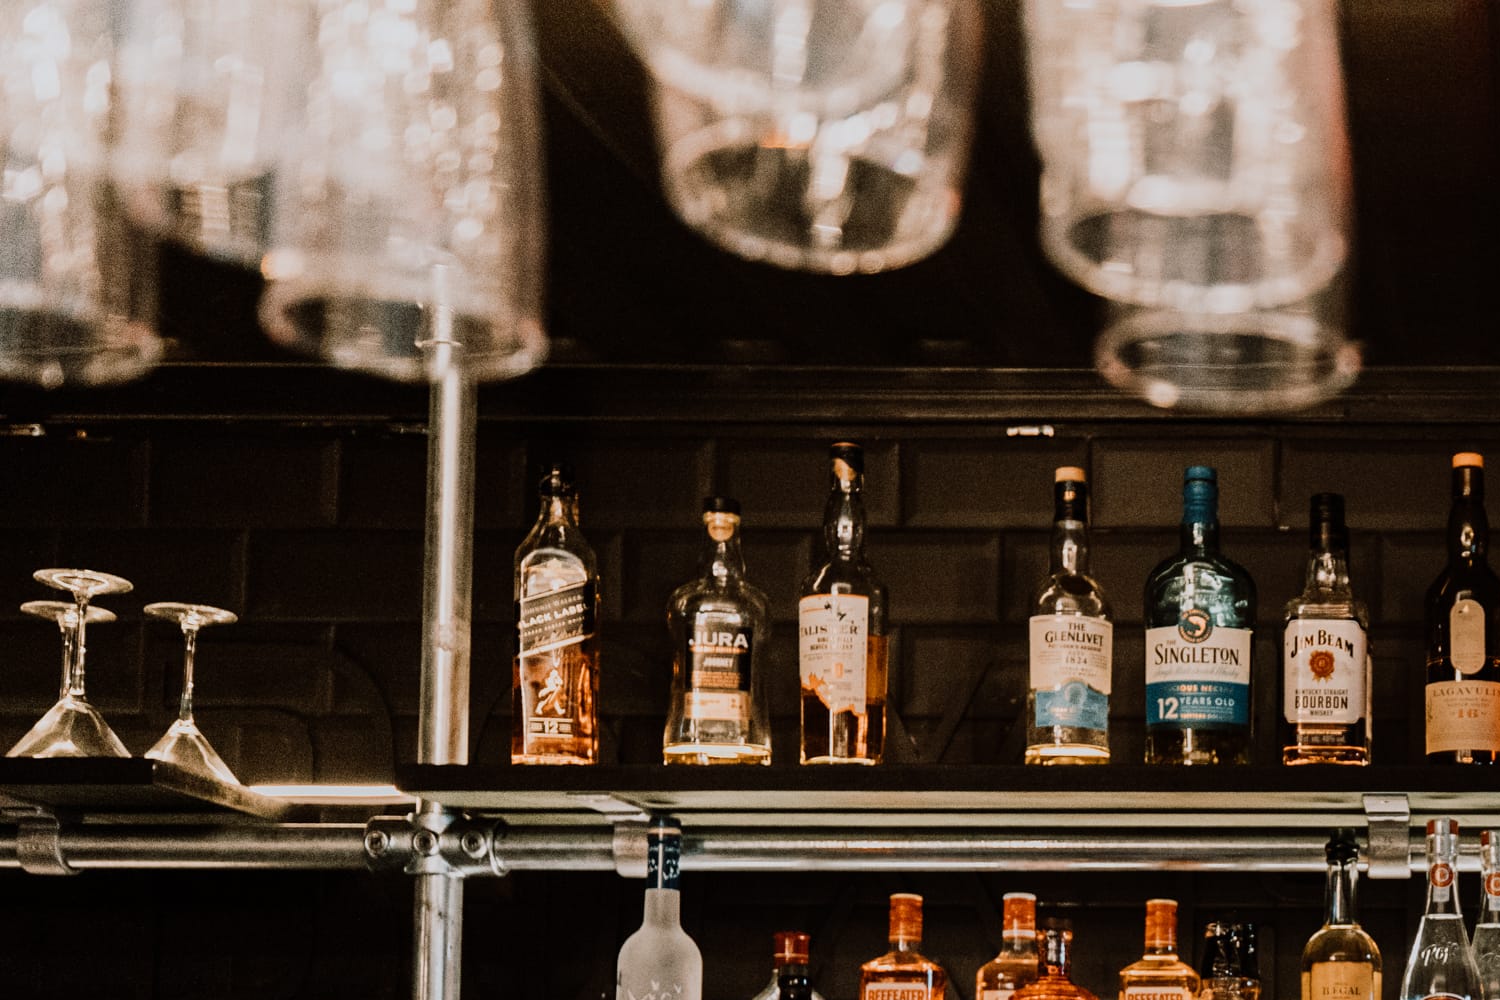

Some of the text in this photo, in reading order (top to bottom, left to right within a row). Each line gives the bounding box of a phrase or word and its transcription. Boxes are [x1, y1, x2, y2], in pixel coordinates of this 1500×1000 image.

[1068, 623, 1086, 631] THE
[688, 631, 749, 649] JURA
[1045, 631, 1104, 647] GLENLIVET
[1318, 629, 1354, 658] BEAM
[1154, 643, 1240, 666] SINGLETON
[1157, 697, 1179, 719] 12
[1180, 697, 1235, 706] YEARS OLD
[1295, 696, 1348, 709] BOURBON
[543, 720, 558, 734] 12
